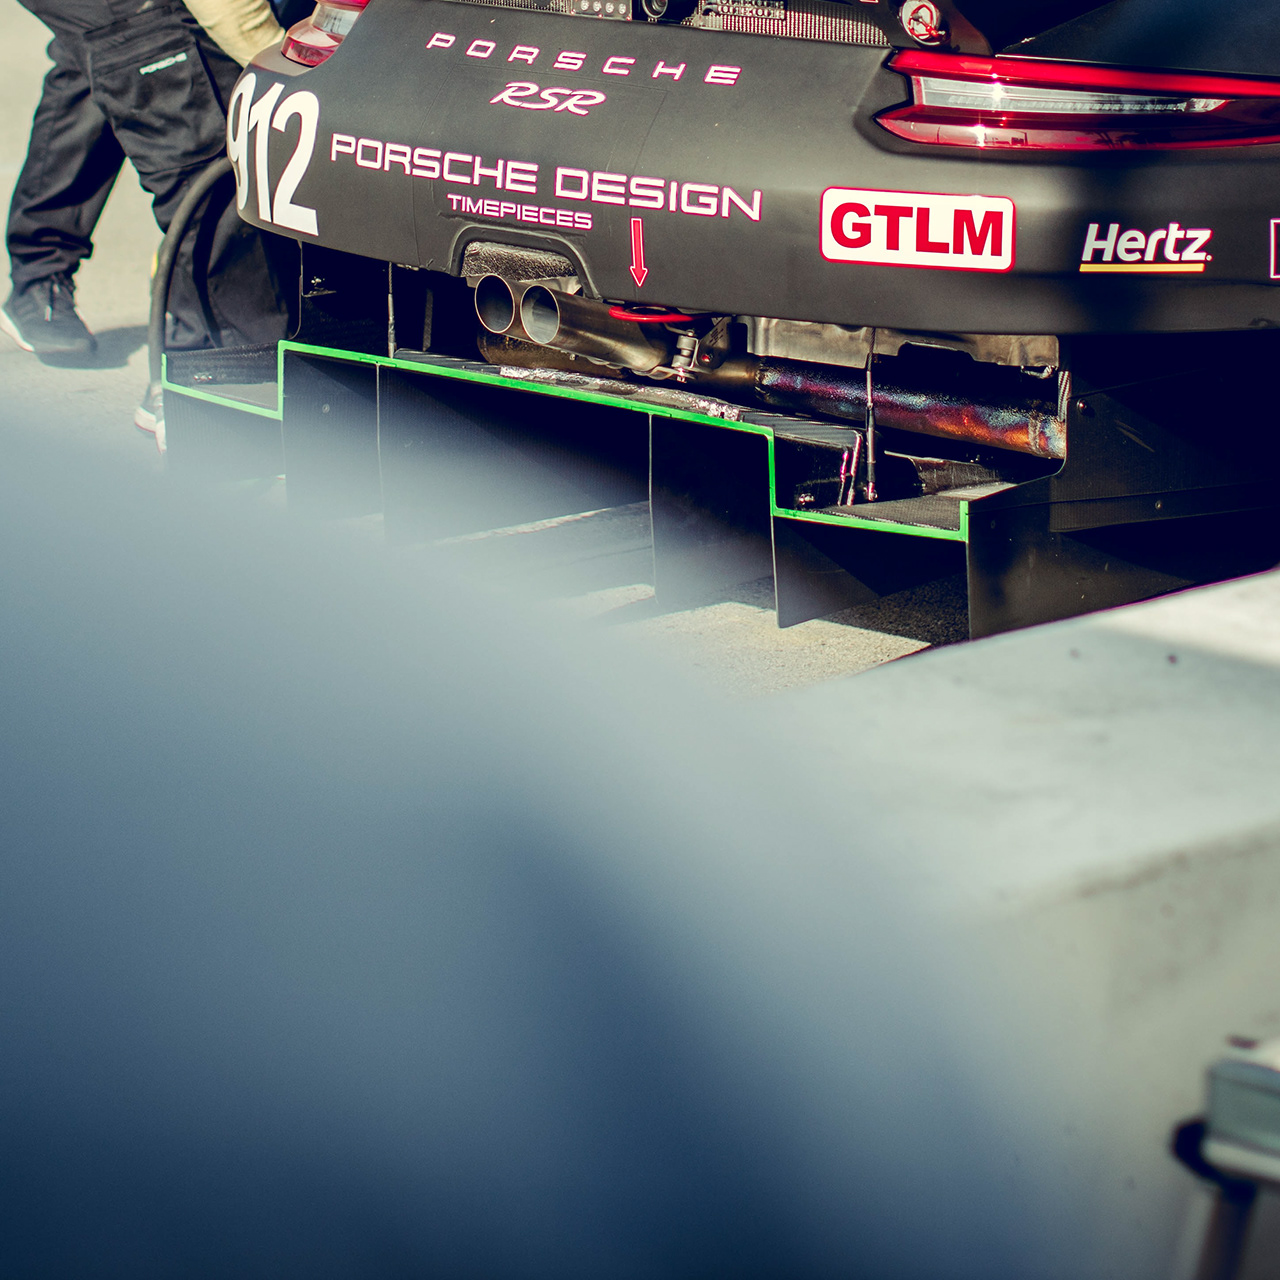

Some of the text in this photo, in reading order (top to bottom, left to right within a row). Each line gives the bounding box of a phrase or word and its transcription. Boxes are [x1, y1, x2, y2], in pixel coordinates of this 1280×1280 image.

[426, 32, 742, 85] PORSCHE
[489, 81, 607, 116] RSR
[226, 72, 320, 237] 912
[330, 133, 762, 222] PORSCHE DESIGN
[446, 193, 593, 230] TIMEPIECES
[830, 202, 1004, 257] GTLM
